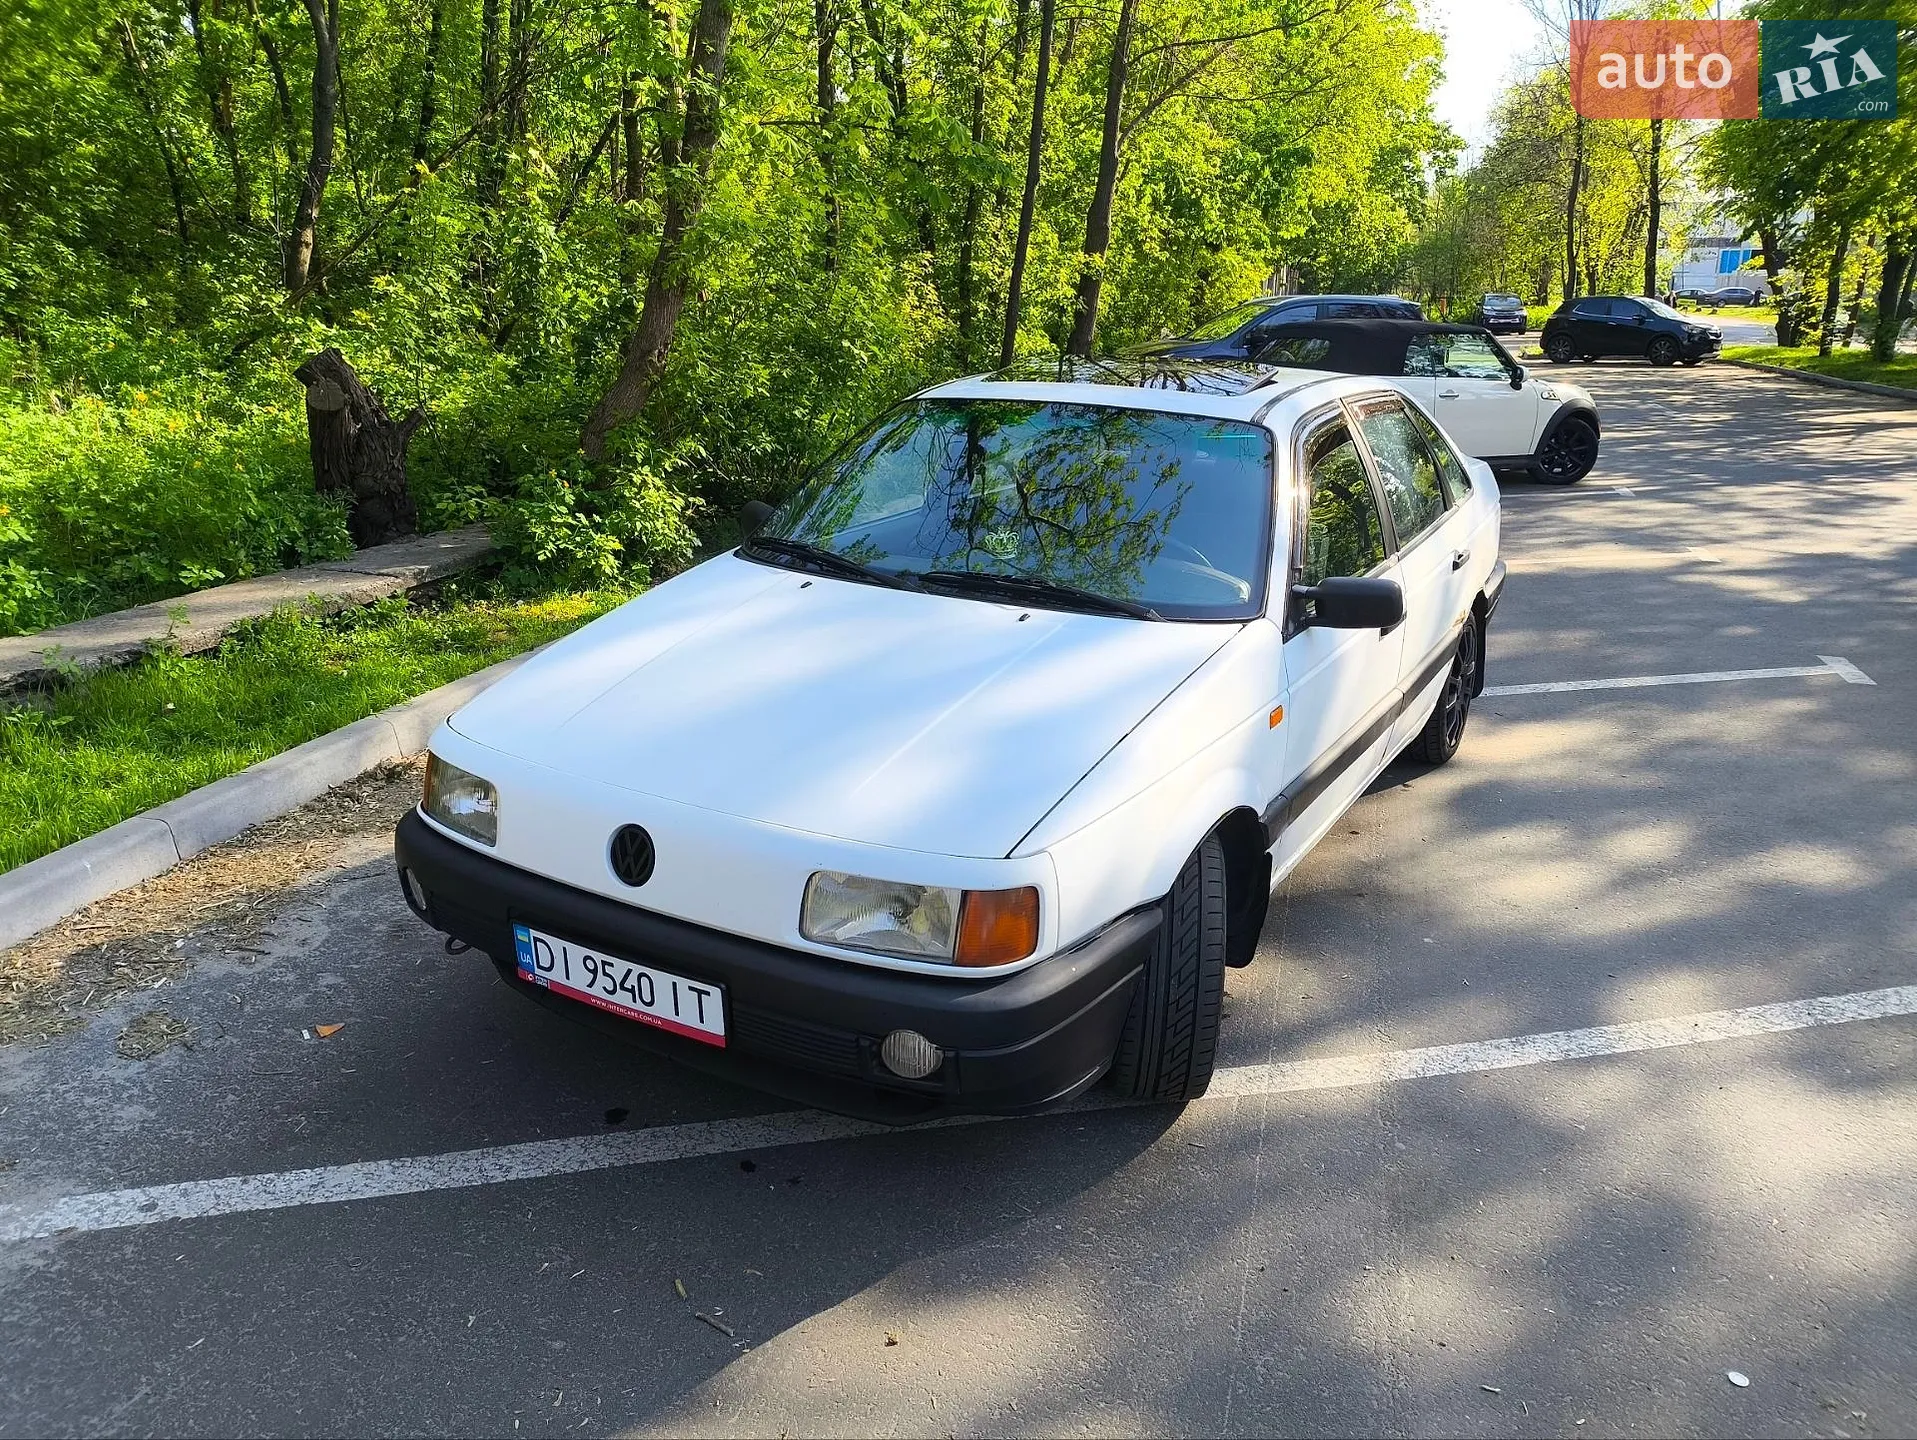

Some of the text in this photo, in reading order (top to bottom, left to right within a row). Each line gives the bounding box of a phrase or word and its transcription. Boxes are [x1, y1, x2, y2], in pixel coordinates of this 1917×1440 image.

[520, 951, 532, 964] UA
[533, 936, 711, 1024] DI 9540 IT
